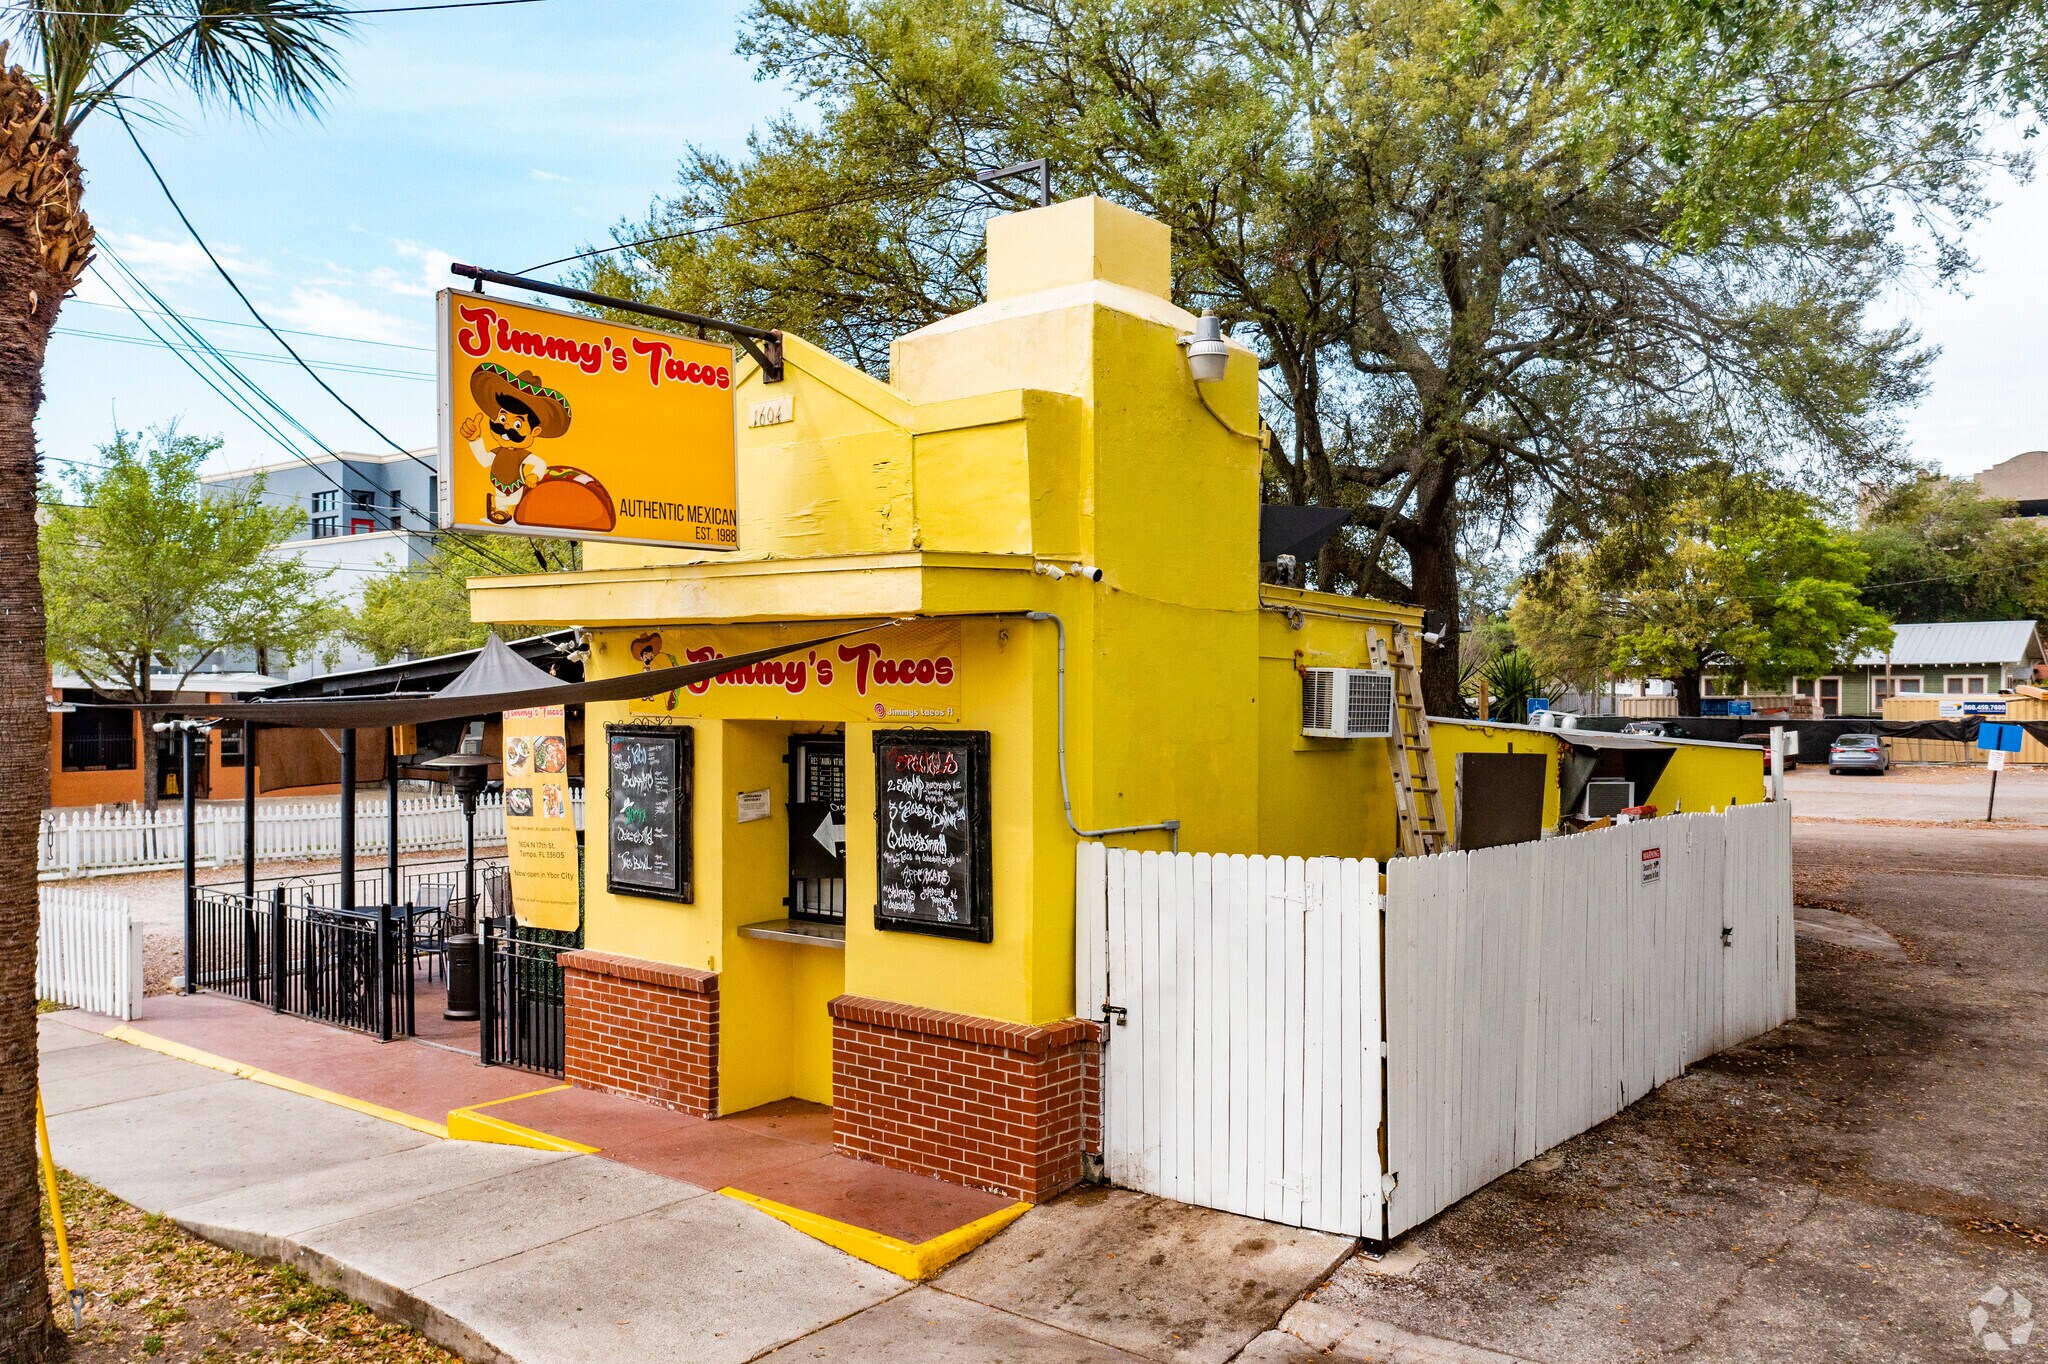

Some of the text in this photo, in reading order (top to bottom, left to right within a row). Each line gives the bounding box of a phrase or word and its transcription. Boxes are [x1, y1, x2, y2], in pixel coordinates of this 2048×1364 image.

[457, 304, 732, 390] Jimmy's Tacos
[754, 404, 781, 426] 1604
[620, 498, 737, 527] AUTHENTIC MEXICAN
[695, 526, 737, 543] EST. 1988
[838, 642, 955, 697] Tacos
[540, 705, 564, 719] Tacos
[920, 706, 945, 717] tacos
[518, 840, 530, 848] 1604
[530, 841, 536, 849] N
[536, 841, 547, 849] 17th
[538, 851, 546, 859] FL
[546, 851, 565, 859] 33605
[1643, 849, 1660, 860] WARNING
[526, 871, 539, 879] open
[540, 870, 546, 878] in
[546, 871, 560, 879] Ybor
[560, 872, 574, 881] City
